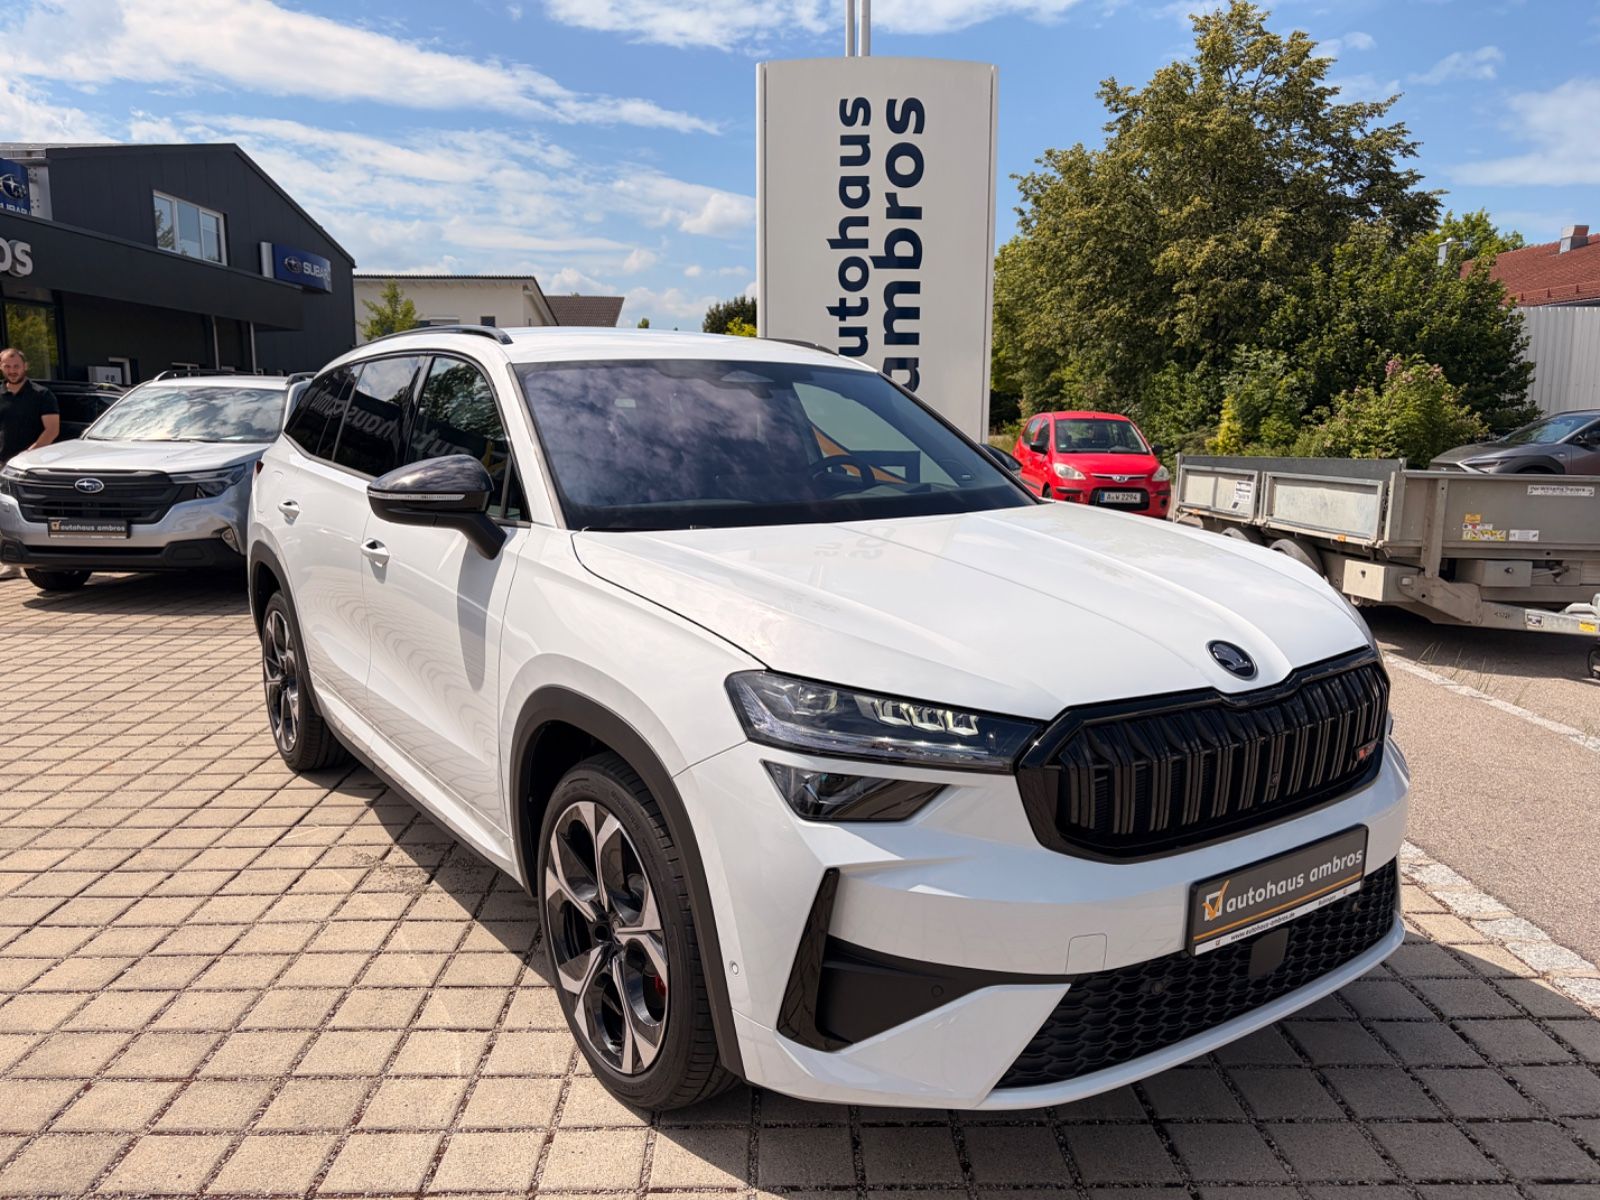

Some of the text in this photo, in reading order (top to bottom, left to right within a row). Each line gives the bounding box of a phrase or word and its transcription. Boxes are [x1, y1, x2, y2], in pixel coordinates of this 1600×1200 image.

[826, 97, 872, 357] utohaus
[870, 97, 925, 393] ambros
[1226, 849, 1363, 913] autohaus ambros
